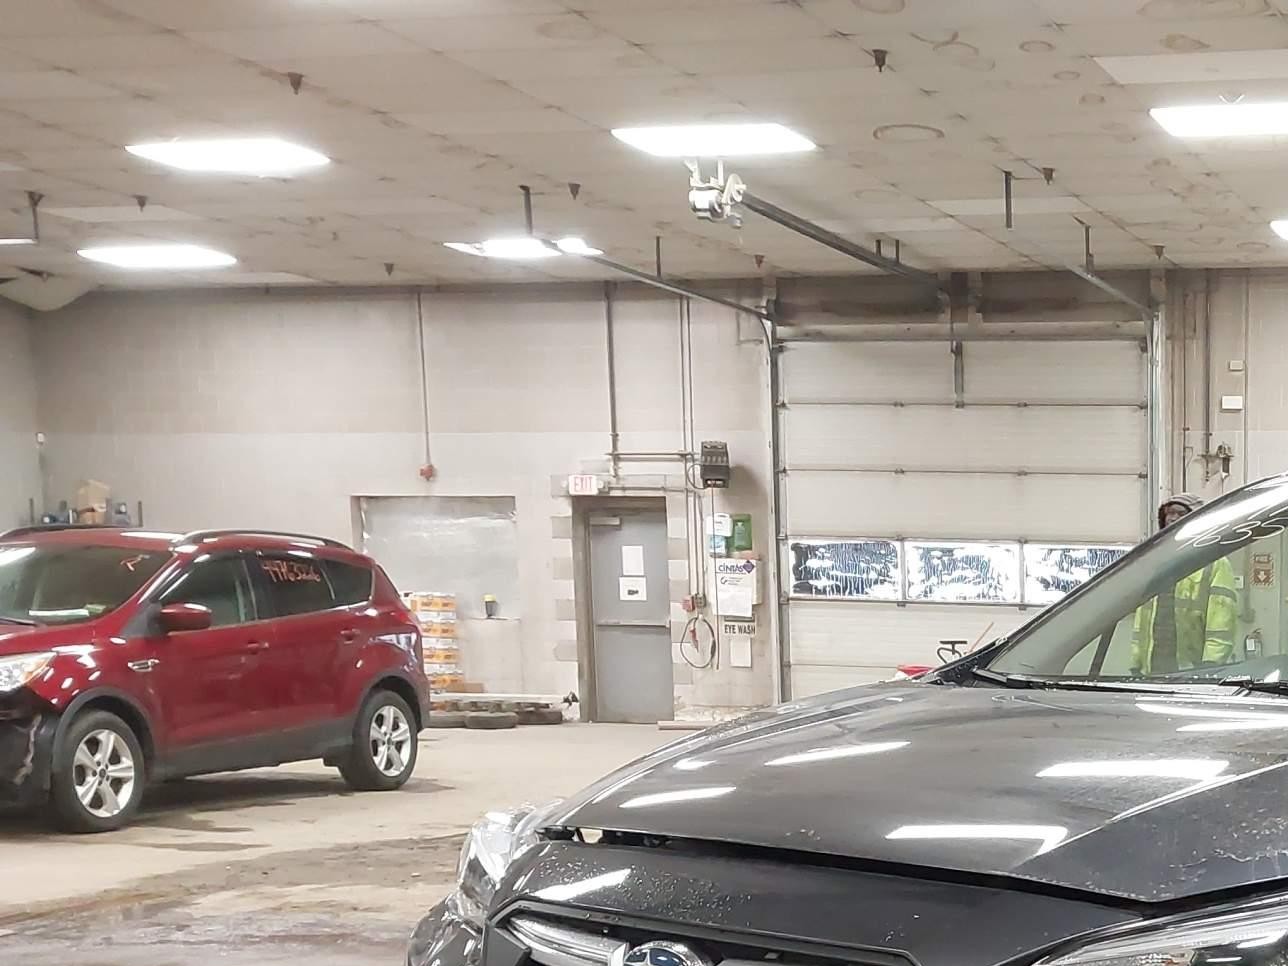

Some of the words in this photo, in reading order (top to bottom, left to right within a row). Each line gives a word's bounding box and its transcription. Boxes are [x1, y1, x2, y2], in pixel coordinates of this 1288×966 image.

[574, 477, 593, 492] EXIT
[724, 624, 736, 634] EYE
[738, 624, 756, 634] WASH
